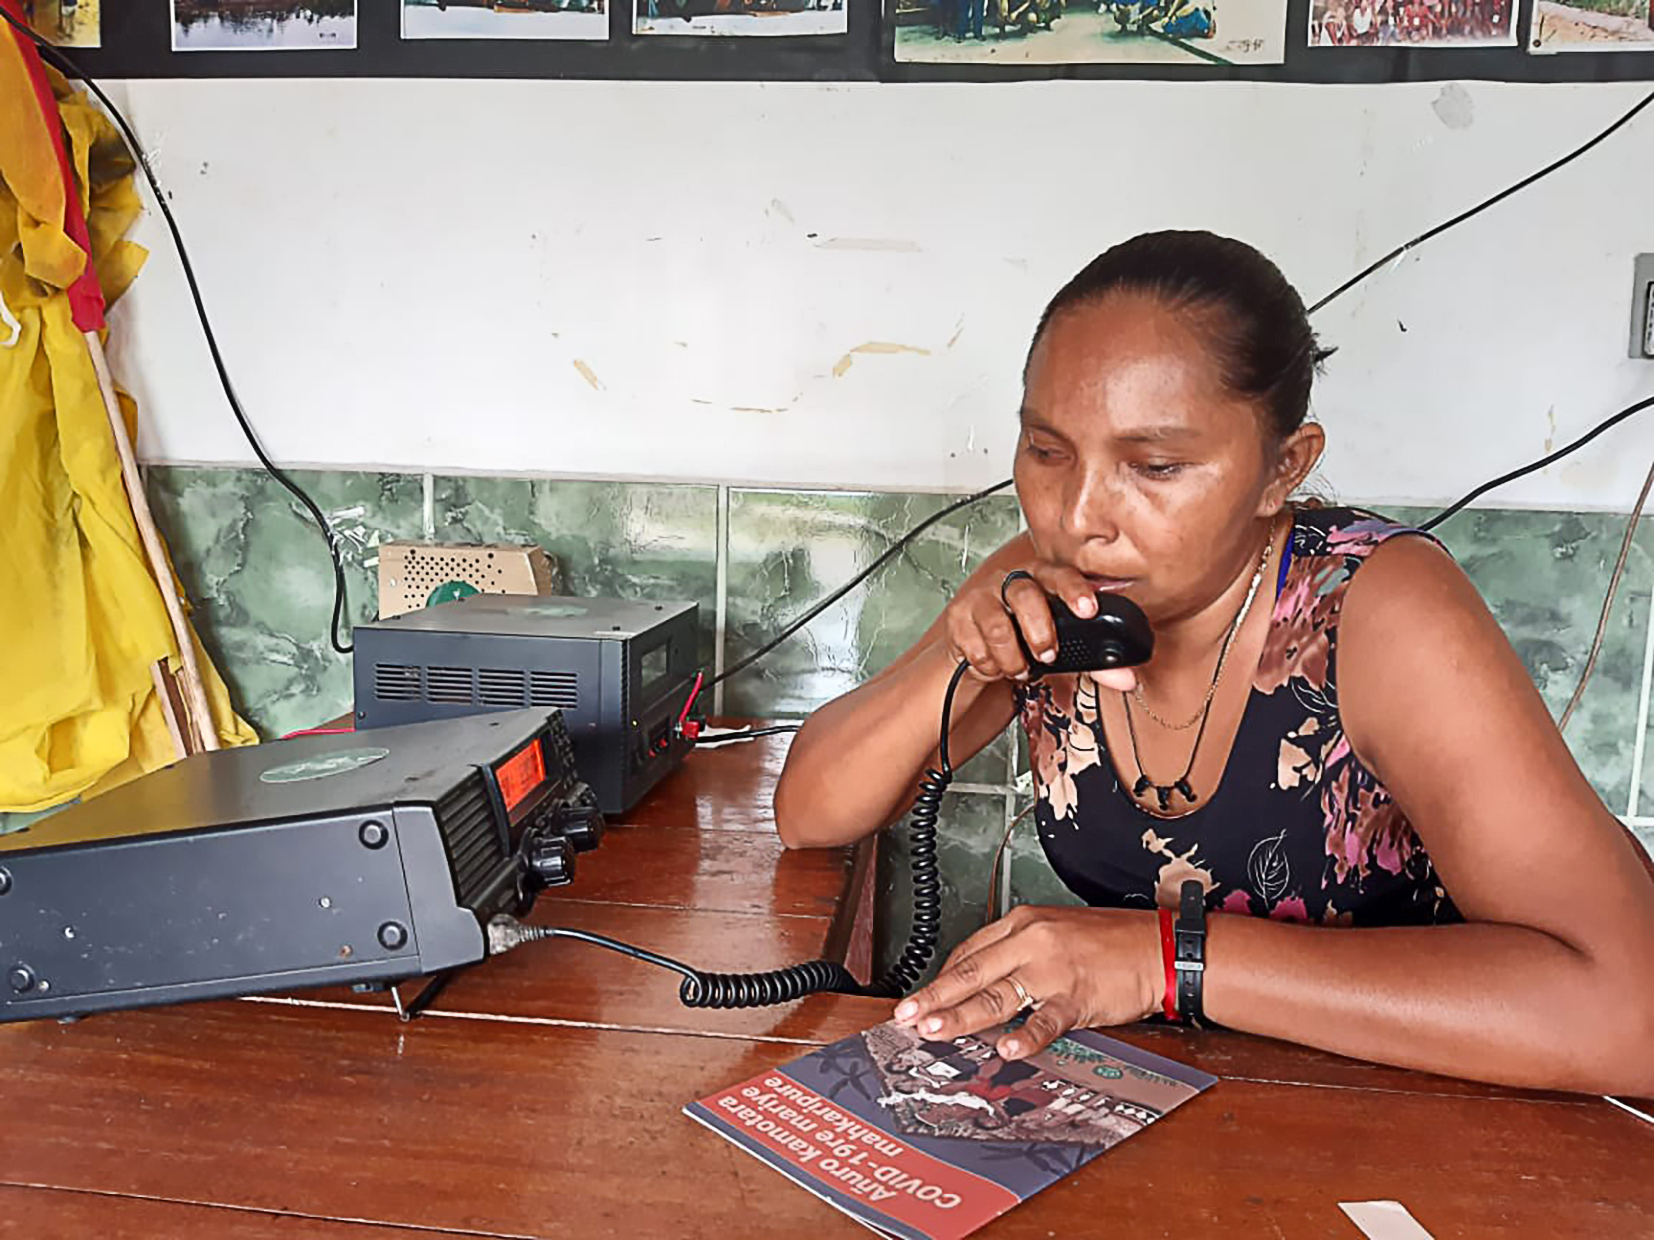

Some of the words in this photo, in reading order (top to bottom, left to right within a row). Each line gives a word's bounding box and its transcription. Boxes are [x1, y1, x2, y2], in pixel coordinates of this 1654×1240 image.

[718, 1095, 822, 1162] kamotara
[741, 1086, 818, 1132] mariye
[764, 1076, 903, 1157] mahkaripure
[815, 1130, 961, 1208] COVID-19re
[819, 1158, 897, 1202] Añuro
